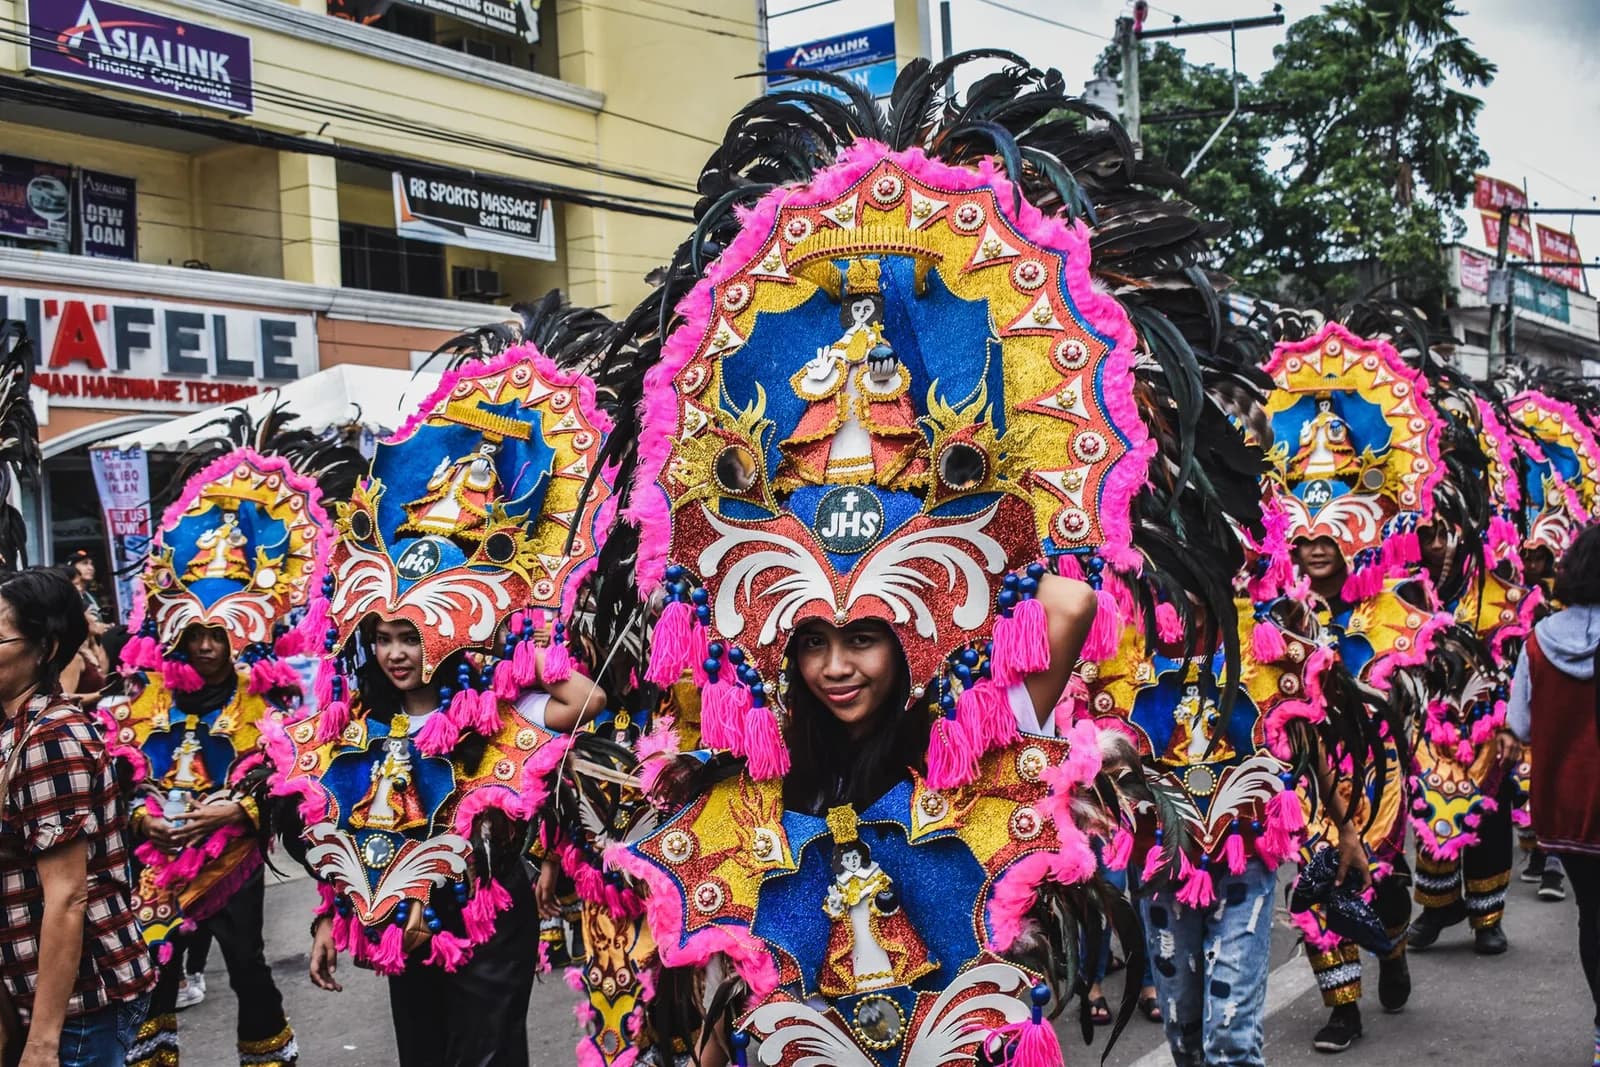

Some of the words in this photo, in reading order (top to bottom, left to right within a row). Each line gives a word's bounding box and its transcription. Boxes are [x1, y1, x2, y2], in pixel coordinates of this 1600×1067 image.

[68, 0, 232, 84] ASIALINK
[791, 36, 870, 66] ASIALINK
[410, 177, 428, 200] RR
[430, 181, 480, 209] SPORTS
[481, 192, 538, 220] MASSAGE
[86, 203, 124, 227] OFW
[479, 211, 500, 228] Soft
[502, 215, 532, 234] Tissue
[85, 223, 126, 247] LOAN
[82, 374, 183, 402] HARDWARE
[1304, 490, 1330, 504] JHS
[129, 510, 145, 522] US
[821, 511, 880, 538] JHS
[398, 553, 435, 574] JHS
